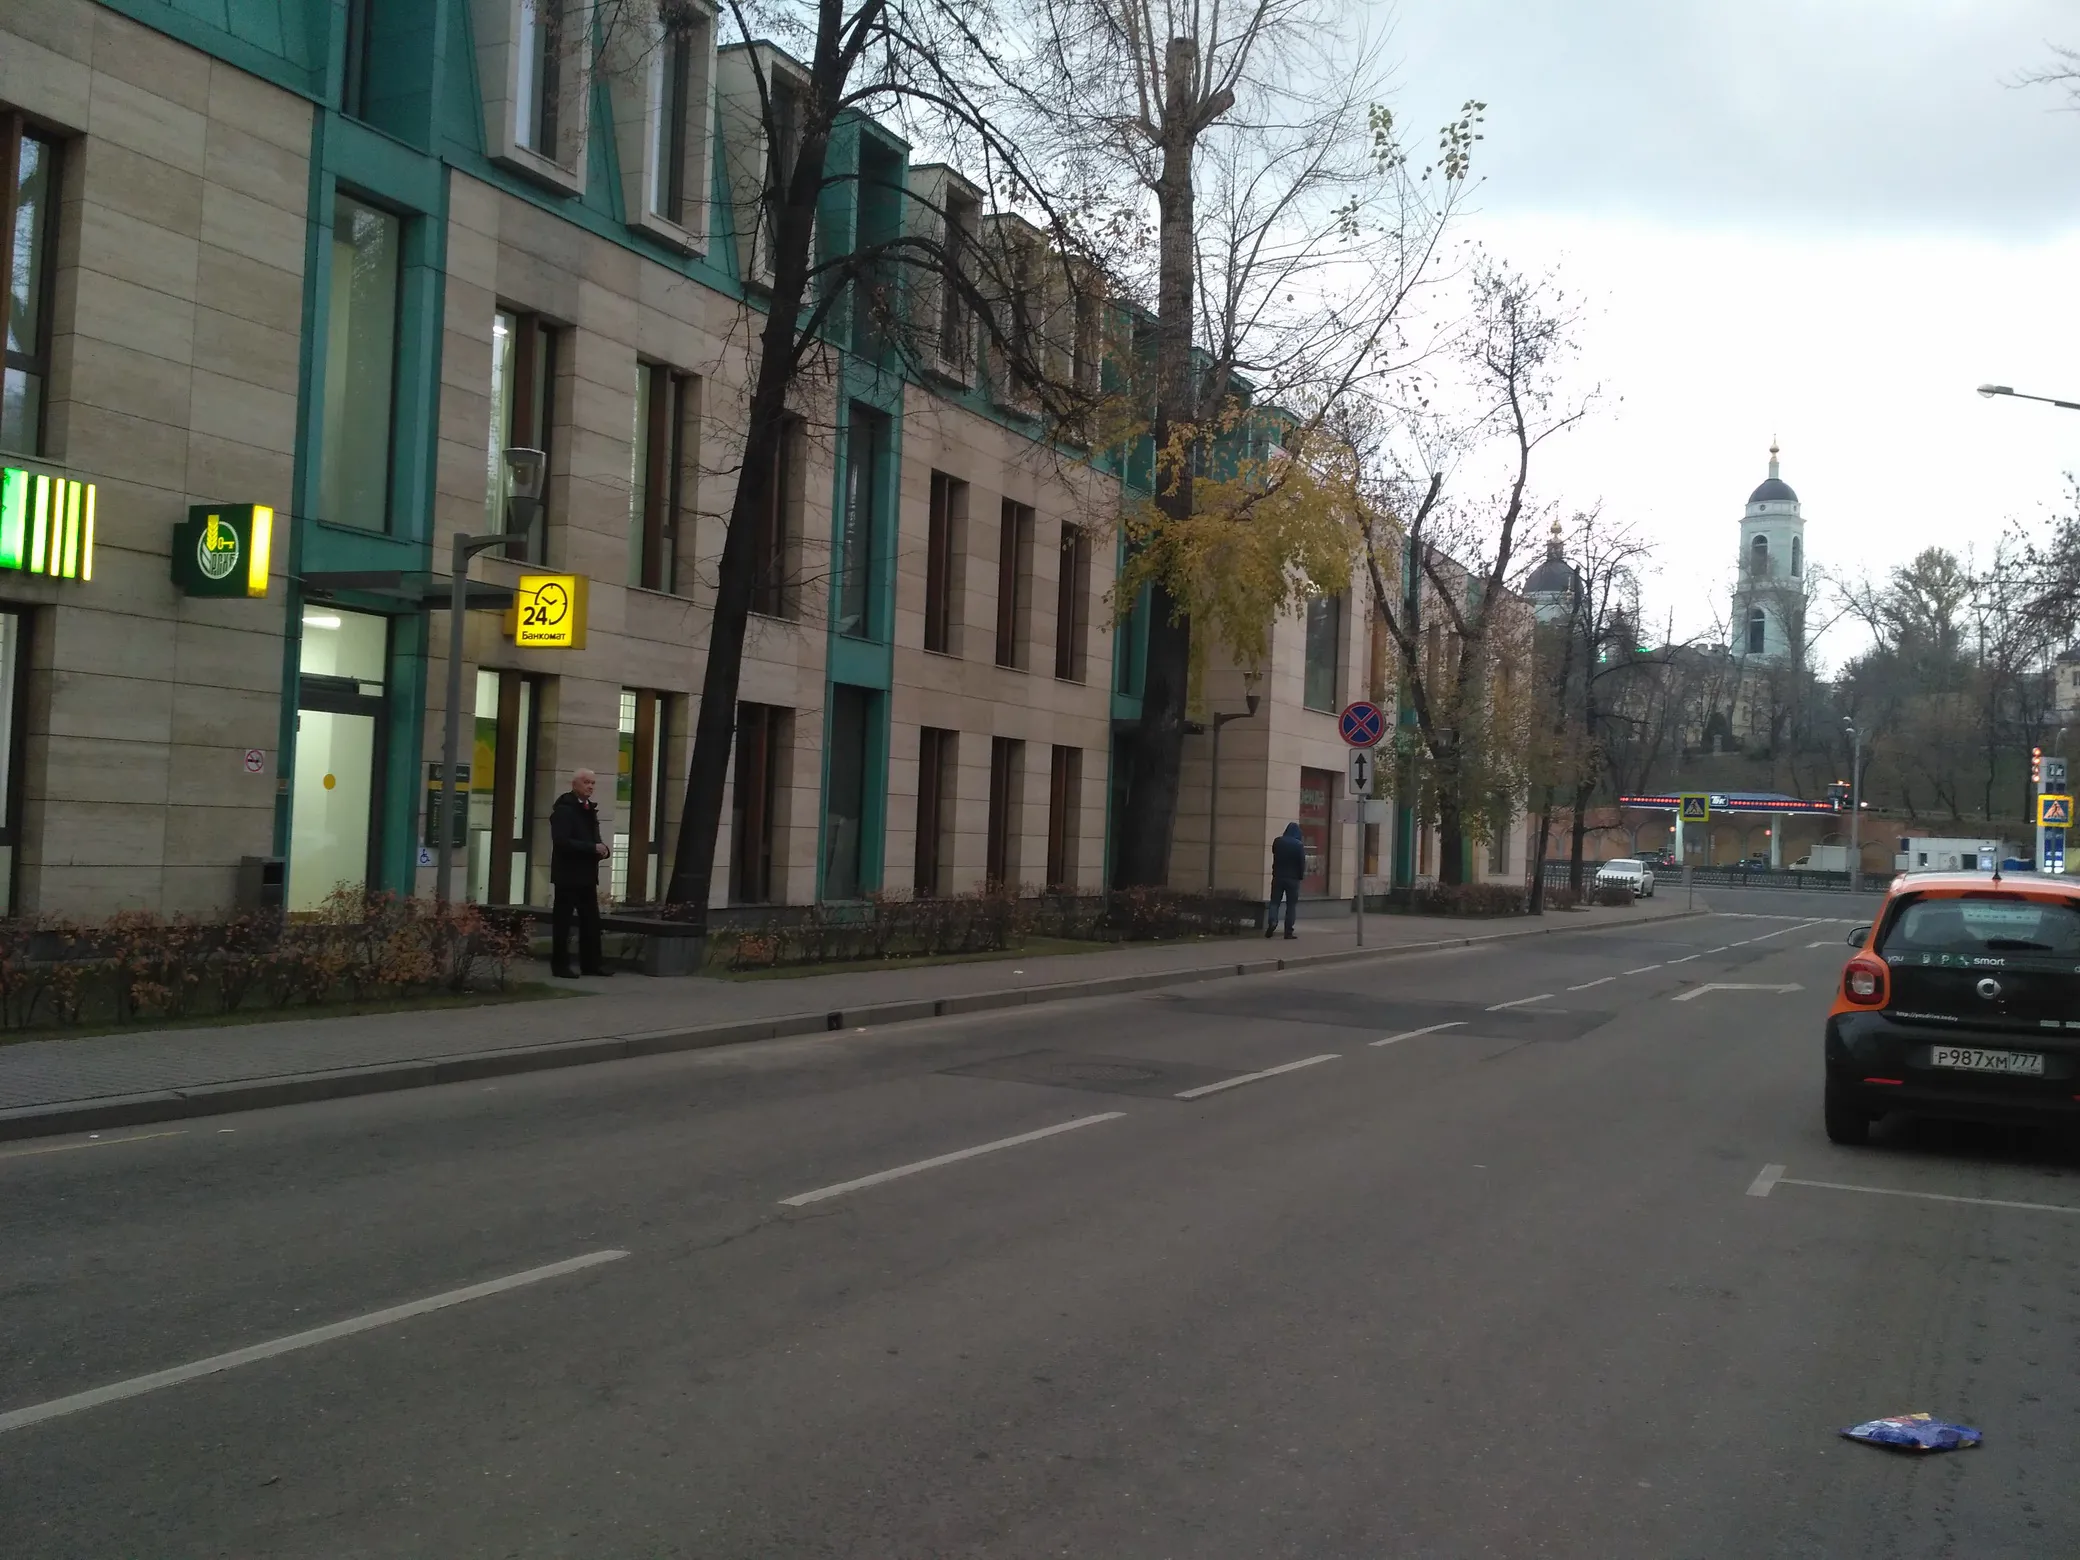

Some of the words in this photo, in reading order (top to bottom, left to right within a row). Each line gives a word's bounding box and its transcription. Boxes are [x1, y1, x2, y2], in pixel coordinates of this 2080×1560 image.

[523, 606, 548, 626] 24
[521, 630, 566, 641] Банкомат
[1973, 956, 2005, 966] smart
[2011, 1053, 2037, 1067] 777
